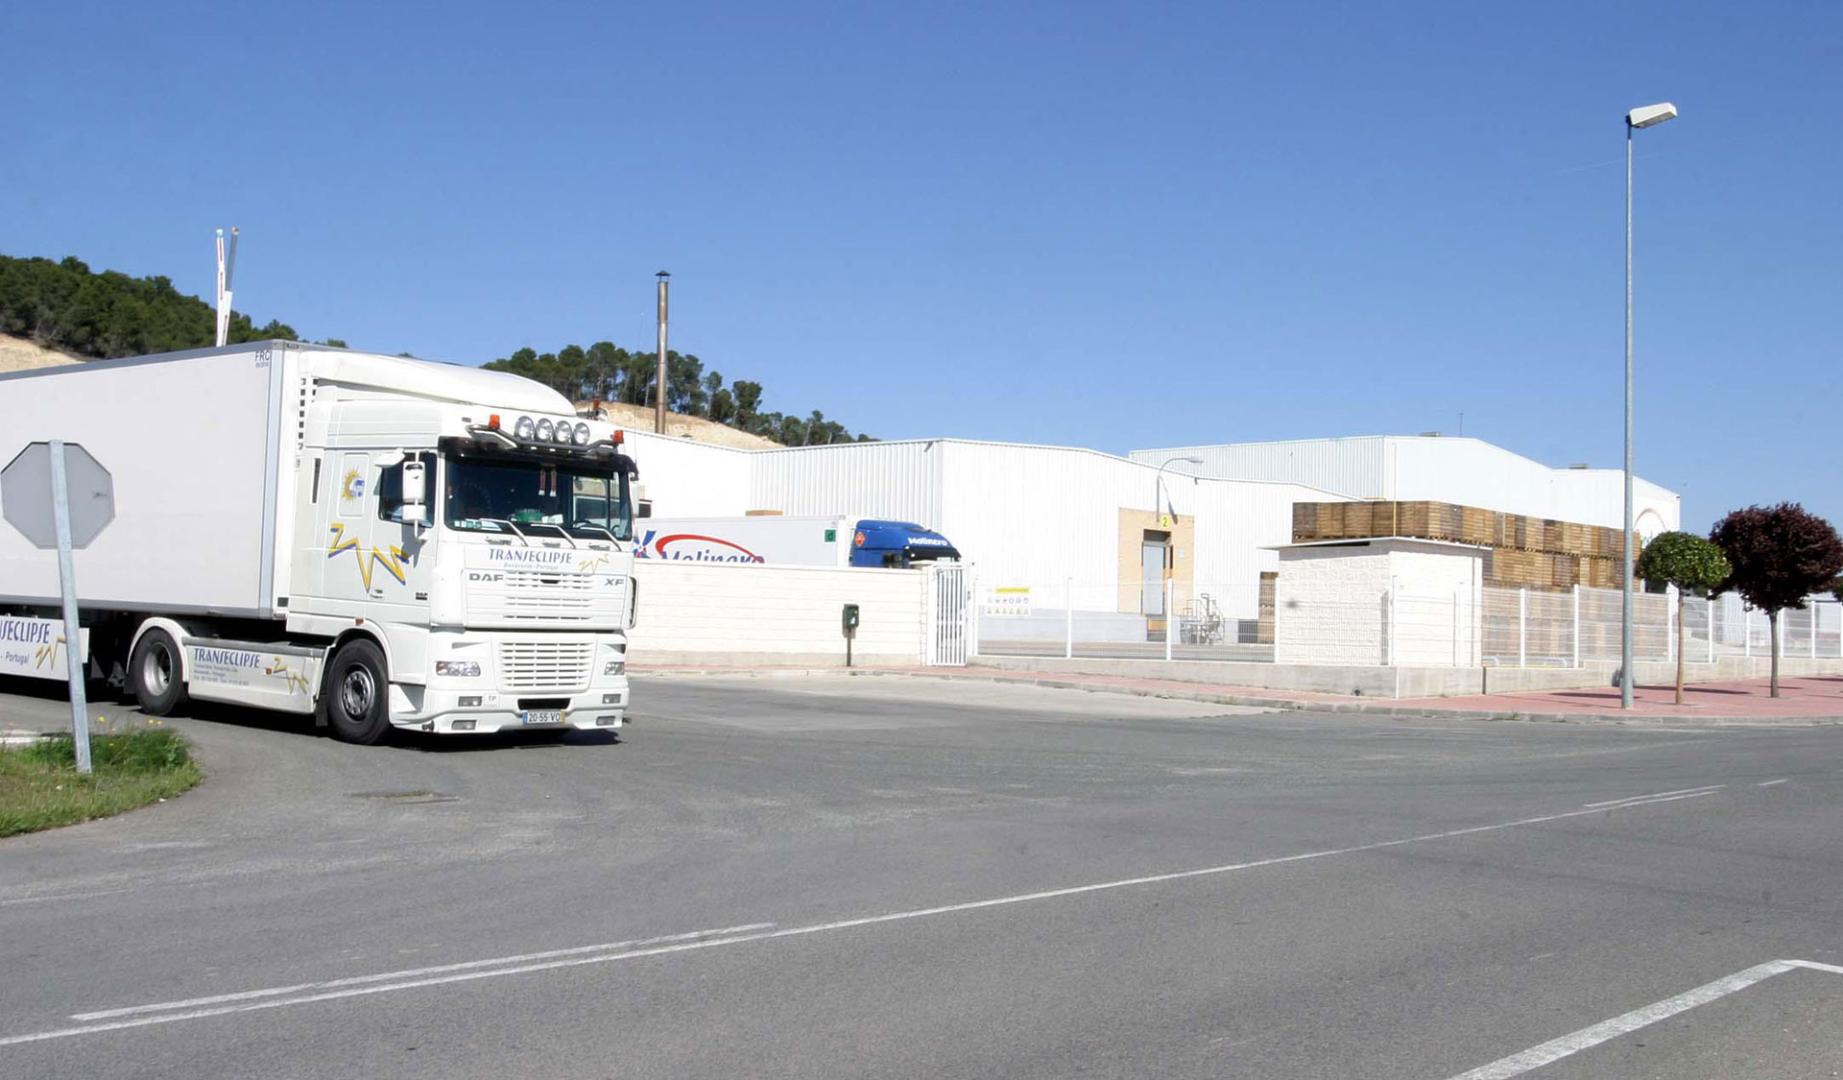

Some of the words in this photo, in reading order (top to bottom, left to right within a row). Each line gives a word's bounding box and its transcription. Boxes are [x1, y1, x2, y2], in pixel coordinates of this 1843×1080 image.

[1162, 516, 1169, 528] 2
[489, 549, 573, 564] TRANSECLIPSE
[468, 573, 504, 582] DAF
[604, 578, 625, 586] XF
[0, 620, 51, 644] SECLIPSE
[193, 648, 260, 668] TRANSECLIPSE
